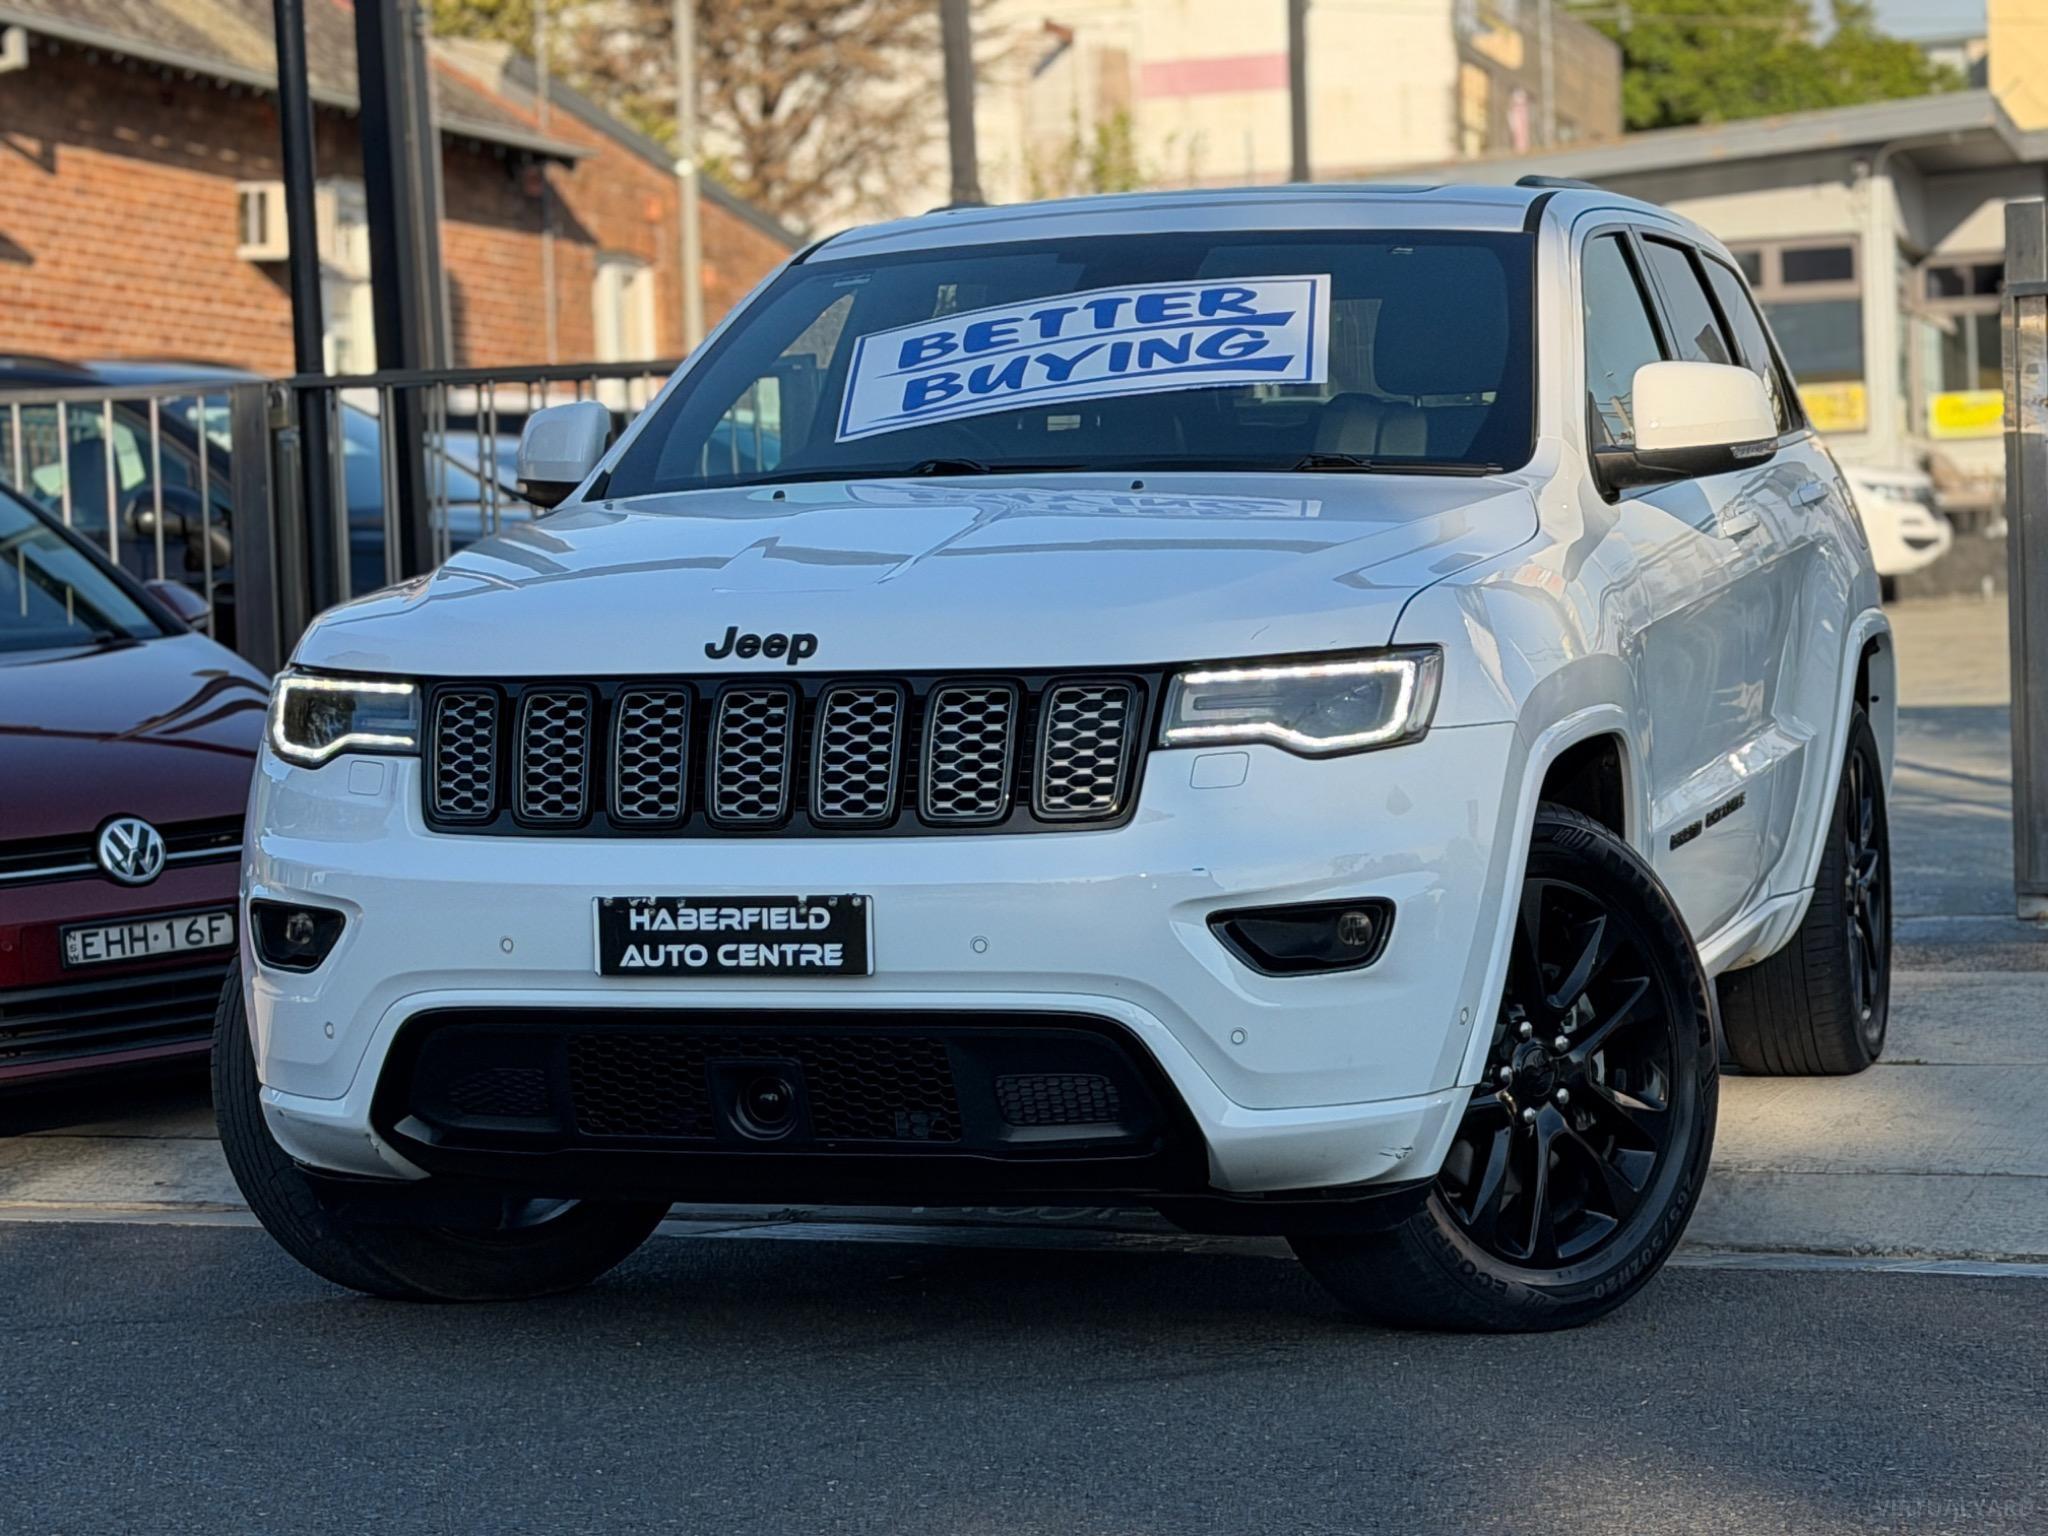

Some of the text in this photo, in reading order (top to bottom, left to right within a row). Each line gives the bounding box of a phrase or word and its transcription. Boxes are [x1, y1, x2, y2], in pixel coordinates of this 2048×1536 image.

[899, 286, 1259, 370] BETTER
[902, 327, 1271, 412] BUYING
[704, 626, 818, 666] Jeep
[629, 906, 831, 932] HABERFIELD
[619, 943, 844, 968] AUTO CENTRE
